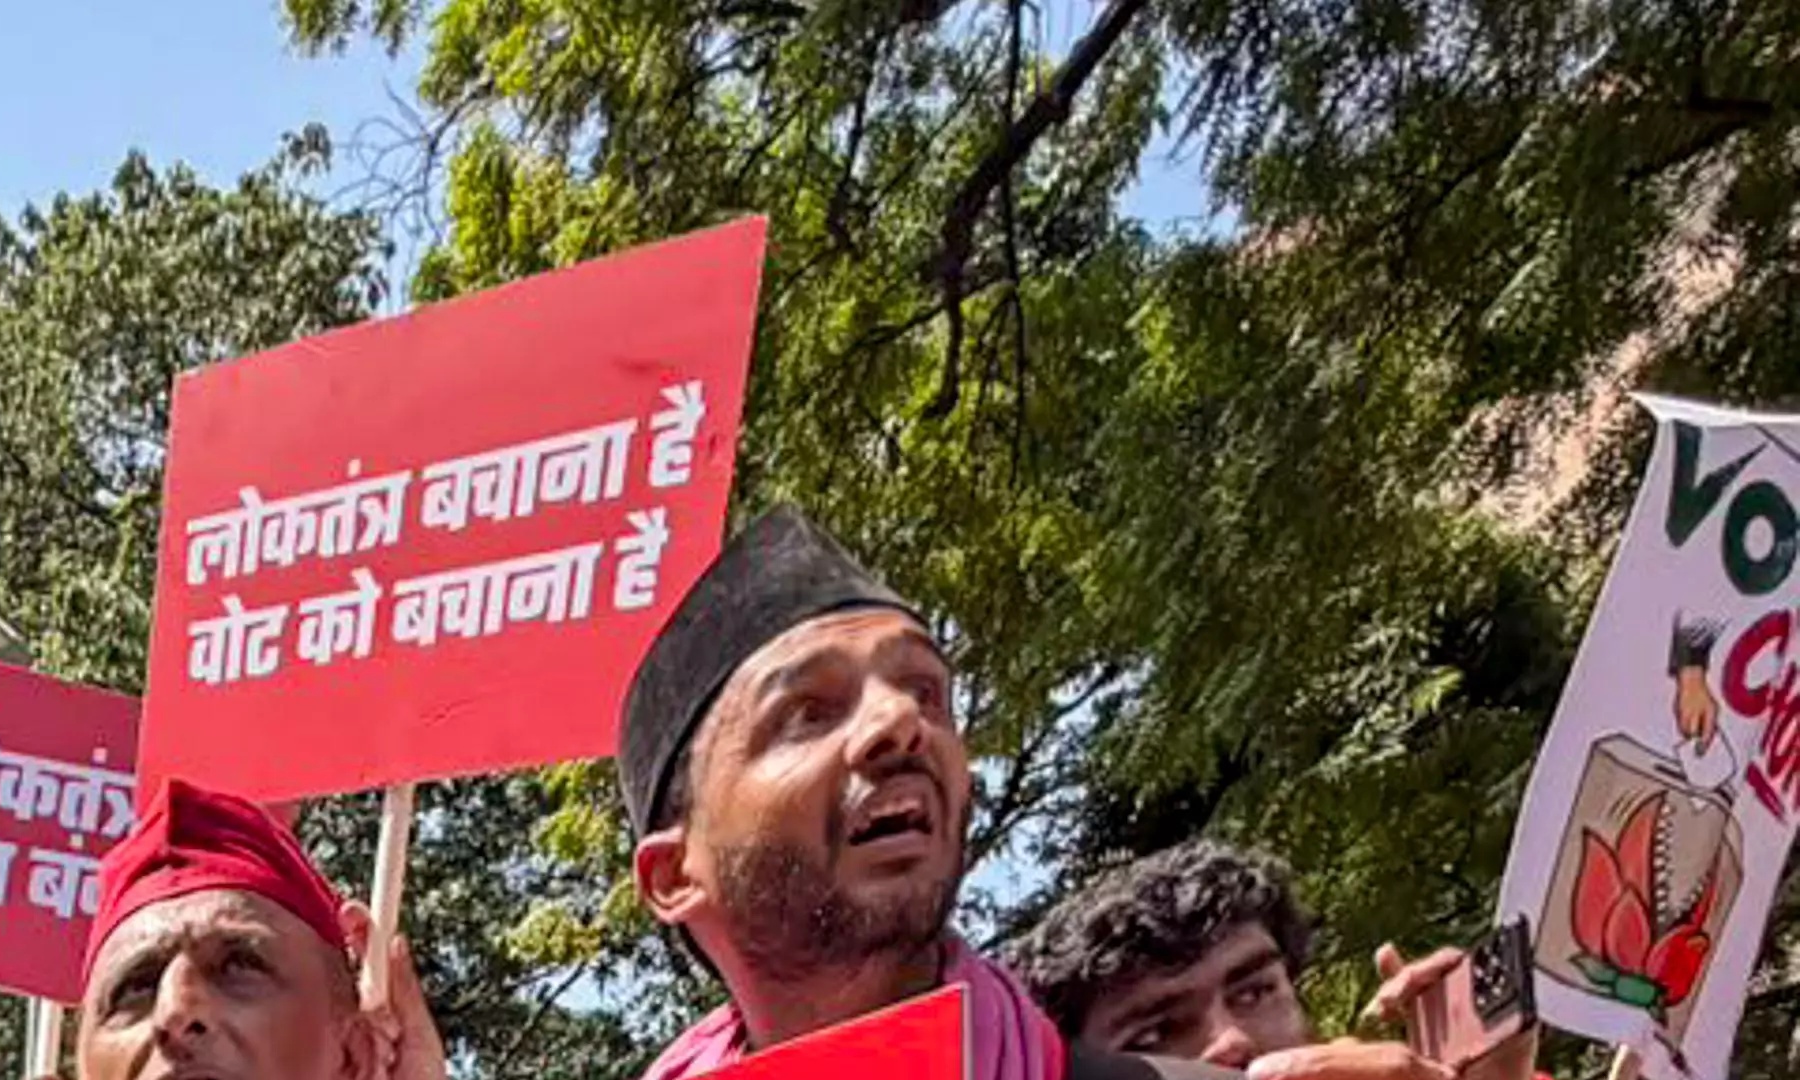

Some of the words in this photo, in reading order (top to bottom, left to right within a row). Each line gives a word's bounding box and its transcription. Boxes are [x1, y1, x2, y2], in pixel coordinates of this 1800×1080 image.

[186, 458, 413, 586] लोकतंत्र
[421, 418, 638, 532] बचाना
[648, 380, 706, 488] है
[1664, 418, 1800, 596] VO
[188, 594, 289, 685] वोट
[297, 567, 383, 666] को
[391, 542, 604, 647] बचाना
[613, 506, 670, 610] है
[29, 833, 106, 919] बं
